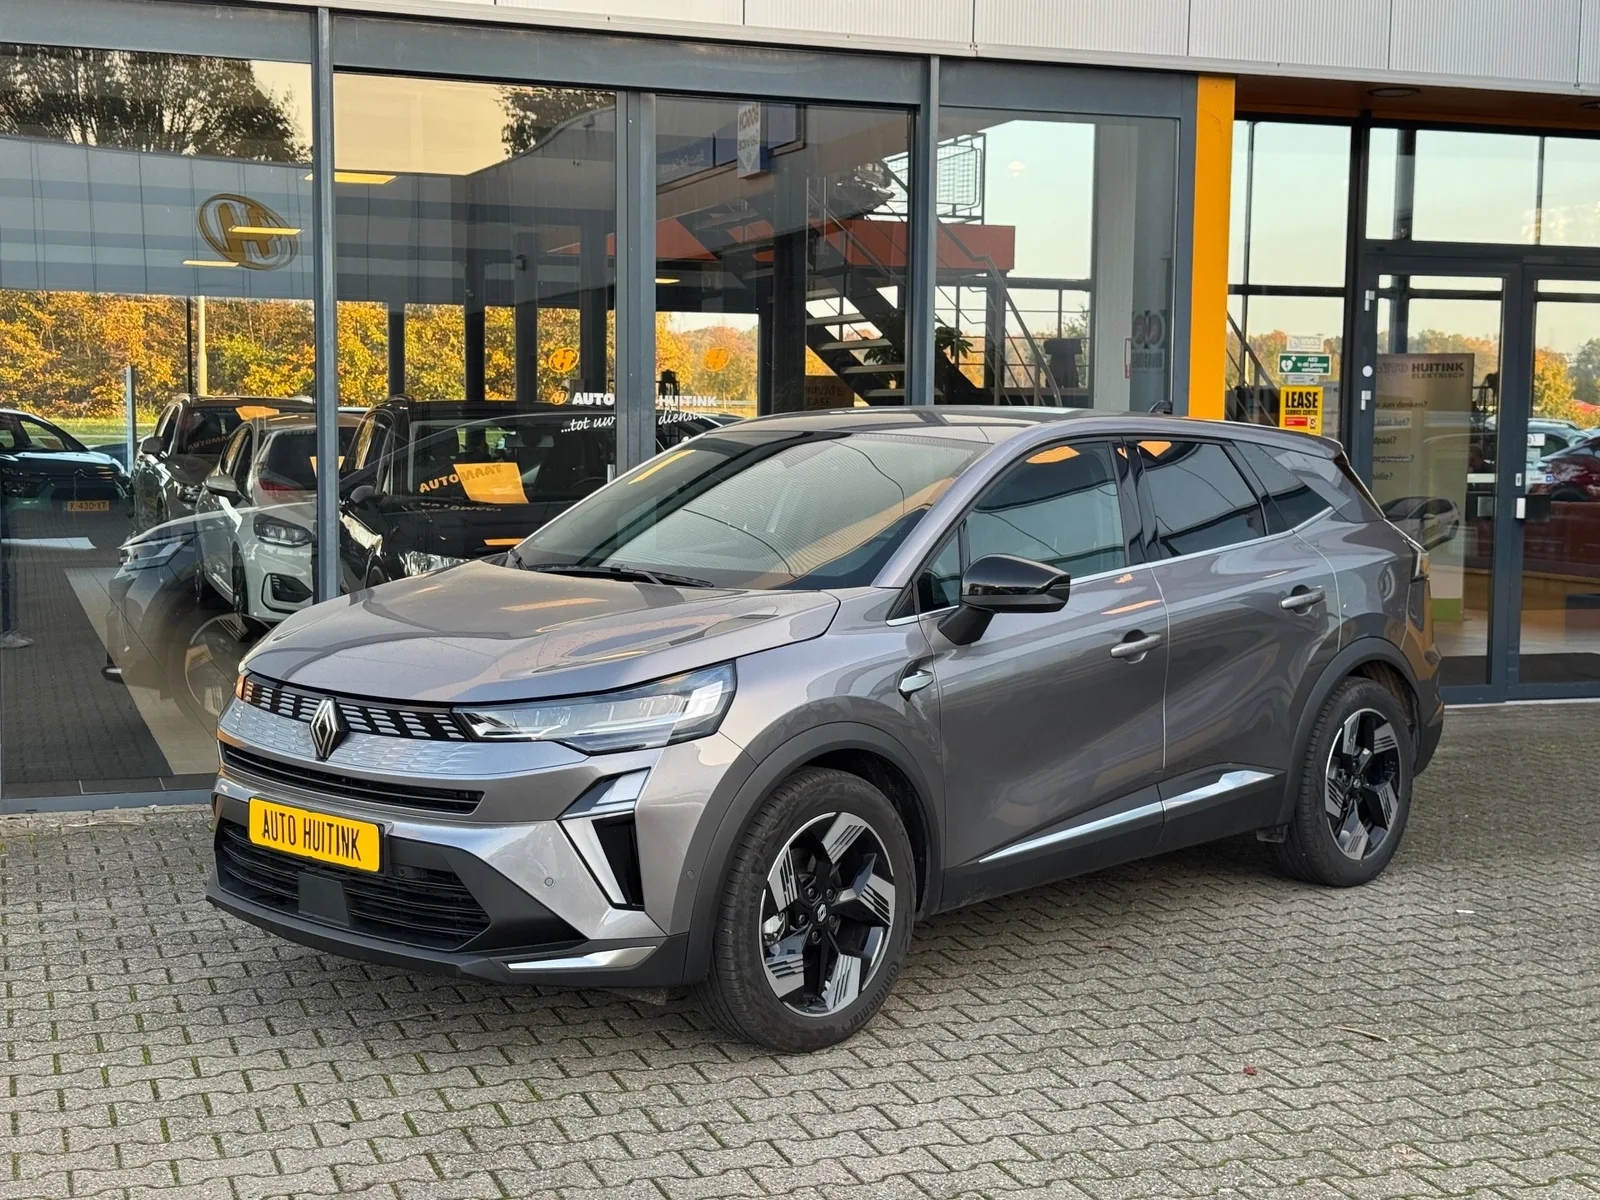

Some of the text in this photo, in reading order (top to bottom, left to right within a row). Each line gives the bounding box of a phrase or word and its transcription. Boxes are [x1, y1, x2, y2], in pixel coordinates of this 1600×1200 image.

[1411, 362, 1464, 373] HUITINK
[1411, 372, 1465, 380] ELEKTRISCH
[806, 385, 845, 396] RIVATE
[572, 393, 615, 406] AUTO
[657, 395, 718, 407] HUITINK
[806, 397, 832, 407] EASE
[1285, 391, 1318, 409] LEASE
[1373, 436, 1397, 445] dpaal?
[419, 463, 502, 494] AUTOMAAT
[263, 808, 362, 862] AUTO HUITINK
[847, 961, 899, 1029] Continental
